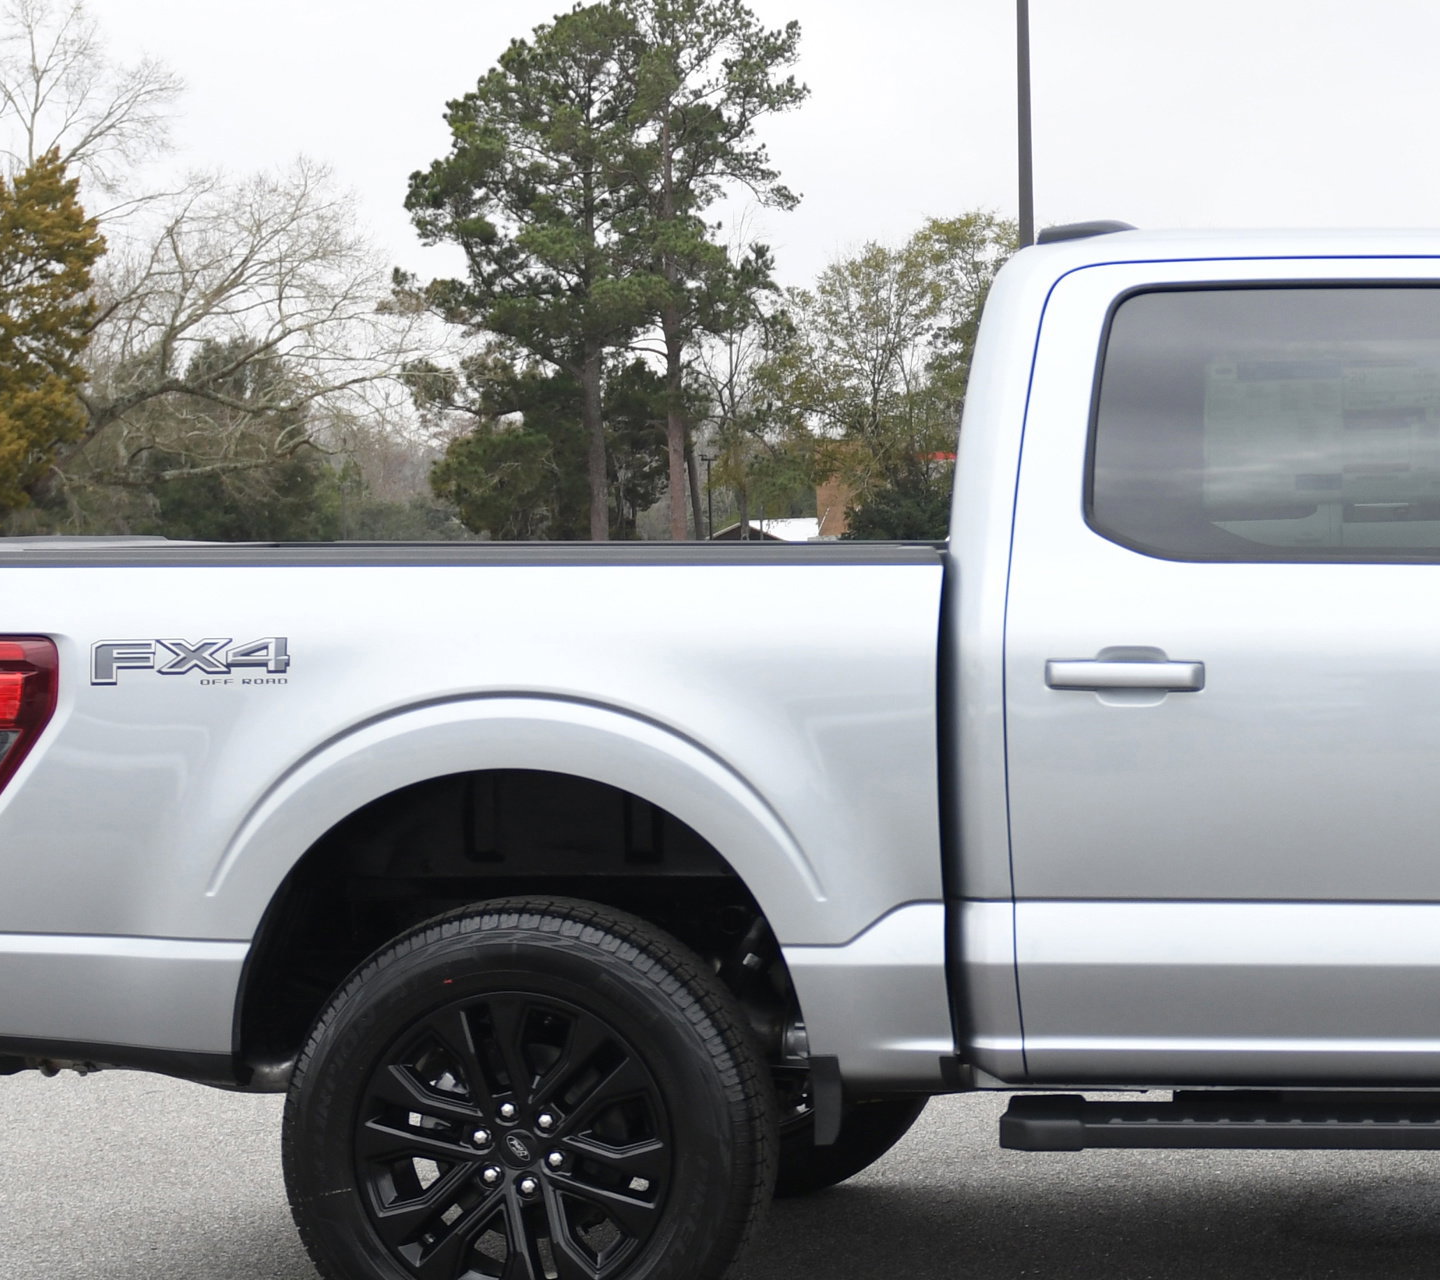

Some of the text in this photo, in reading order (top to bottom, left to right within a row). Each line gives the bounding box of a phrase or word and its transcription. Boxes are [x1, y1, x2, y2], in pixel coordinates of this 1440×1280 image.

[90, 637, 290, 686] FX4
[200, 677, 288, 686] OFF ROAD
